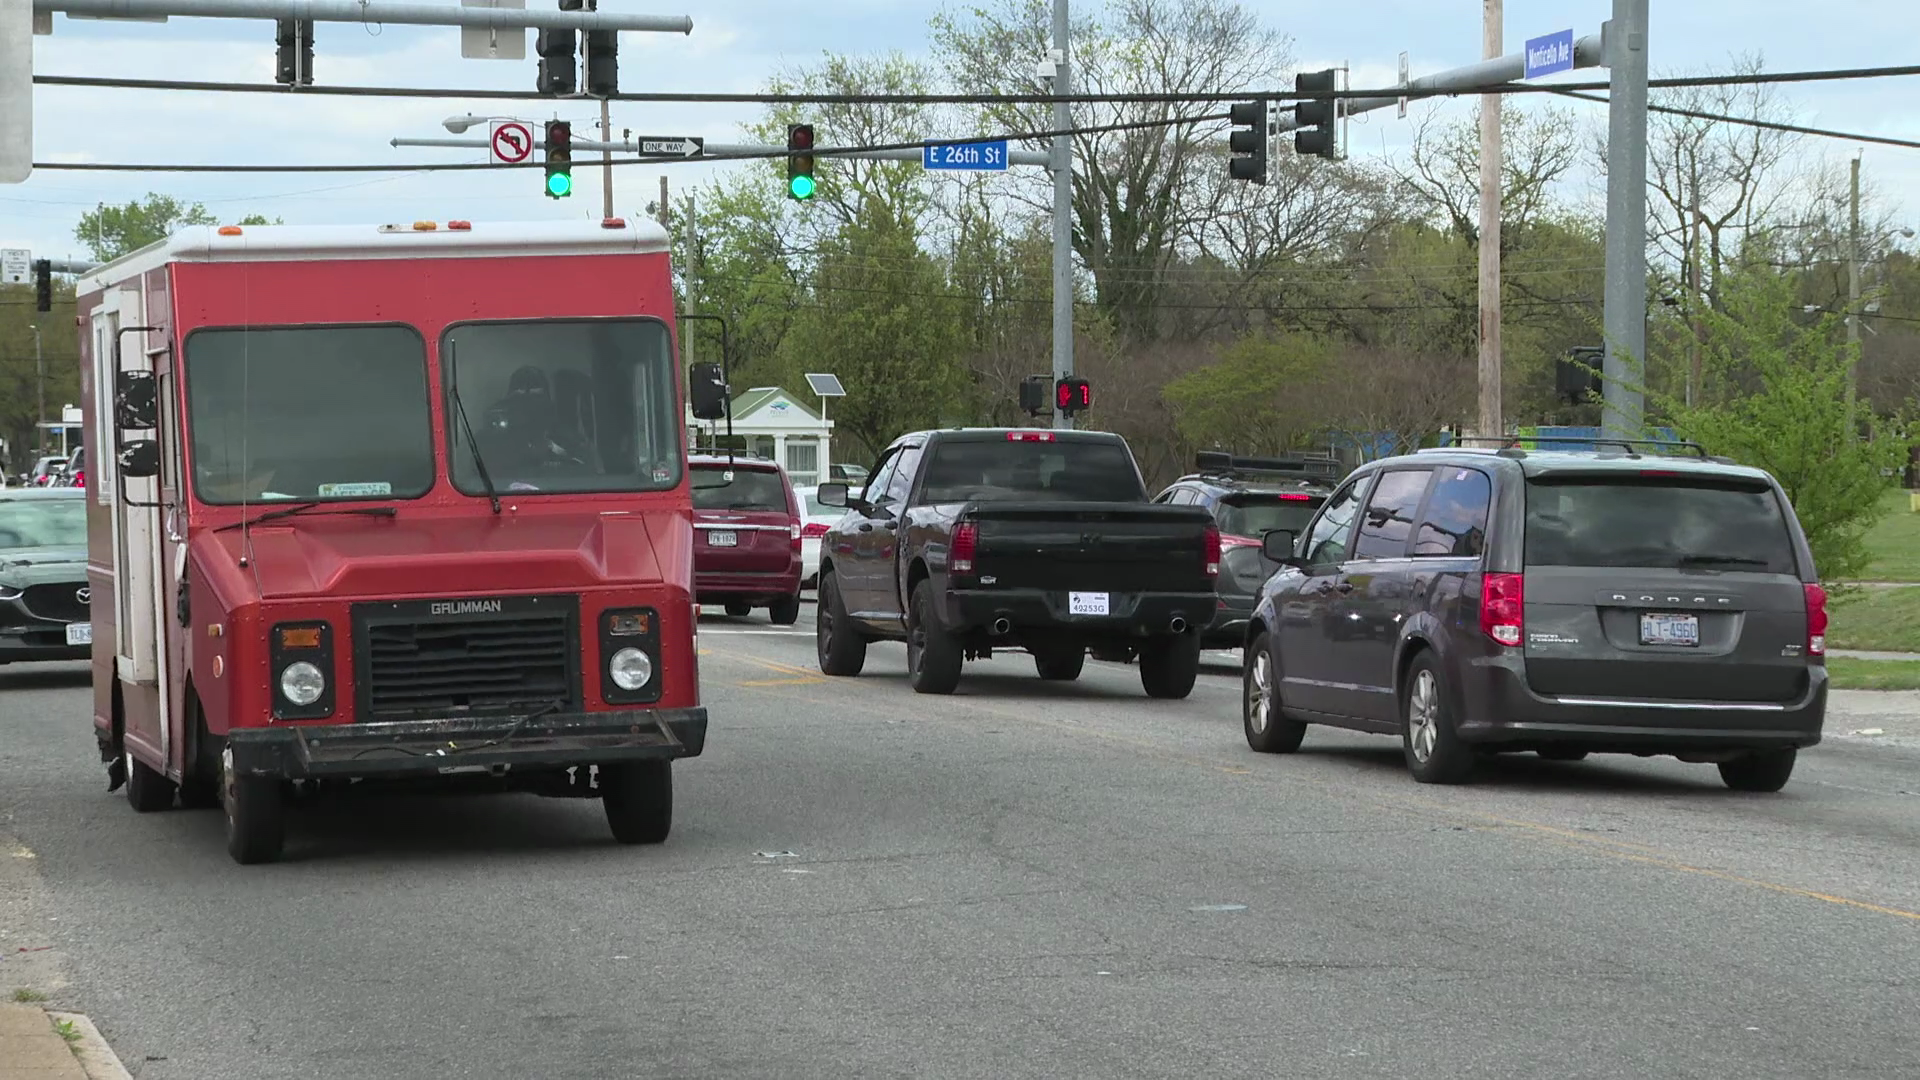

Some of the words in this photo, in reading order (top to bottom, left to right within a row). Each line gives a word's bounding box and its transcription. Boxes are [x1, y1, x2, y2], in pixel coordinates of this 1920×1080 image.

[1529, 43, 1557, 69] Monticello
[1558, 40, 1569, 62] Ave
[645, 142, 663, 151] ONE
[665, 143, 684, 152] WAY
[930, 146, 939, 163] E
[945, 146, 979, 164] 26th
[984, 146, 1001, 164] St
[431, 600, 502, 614] GRUMMAN
